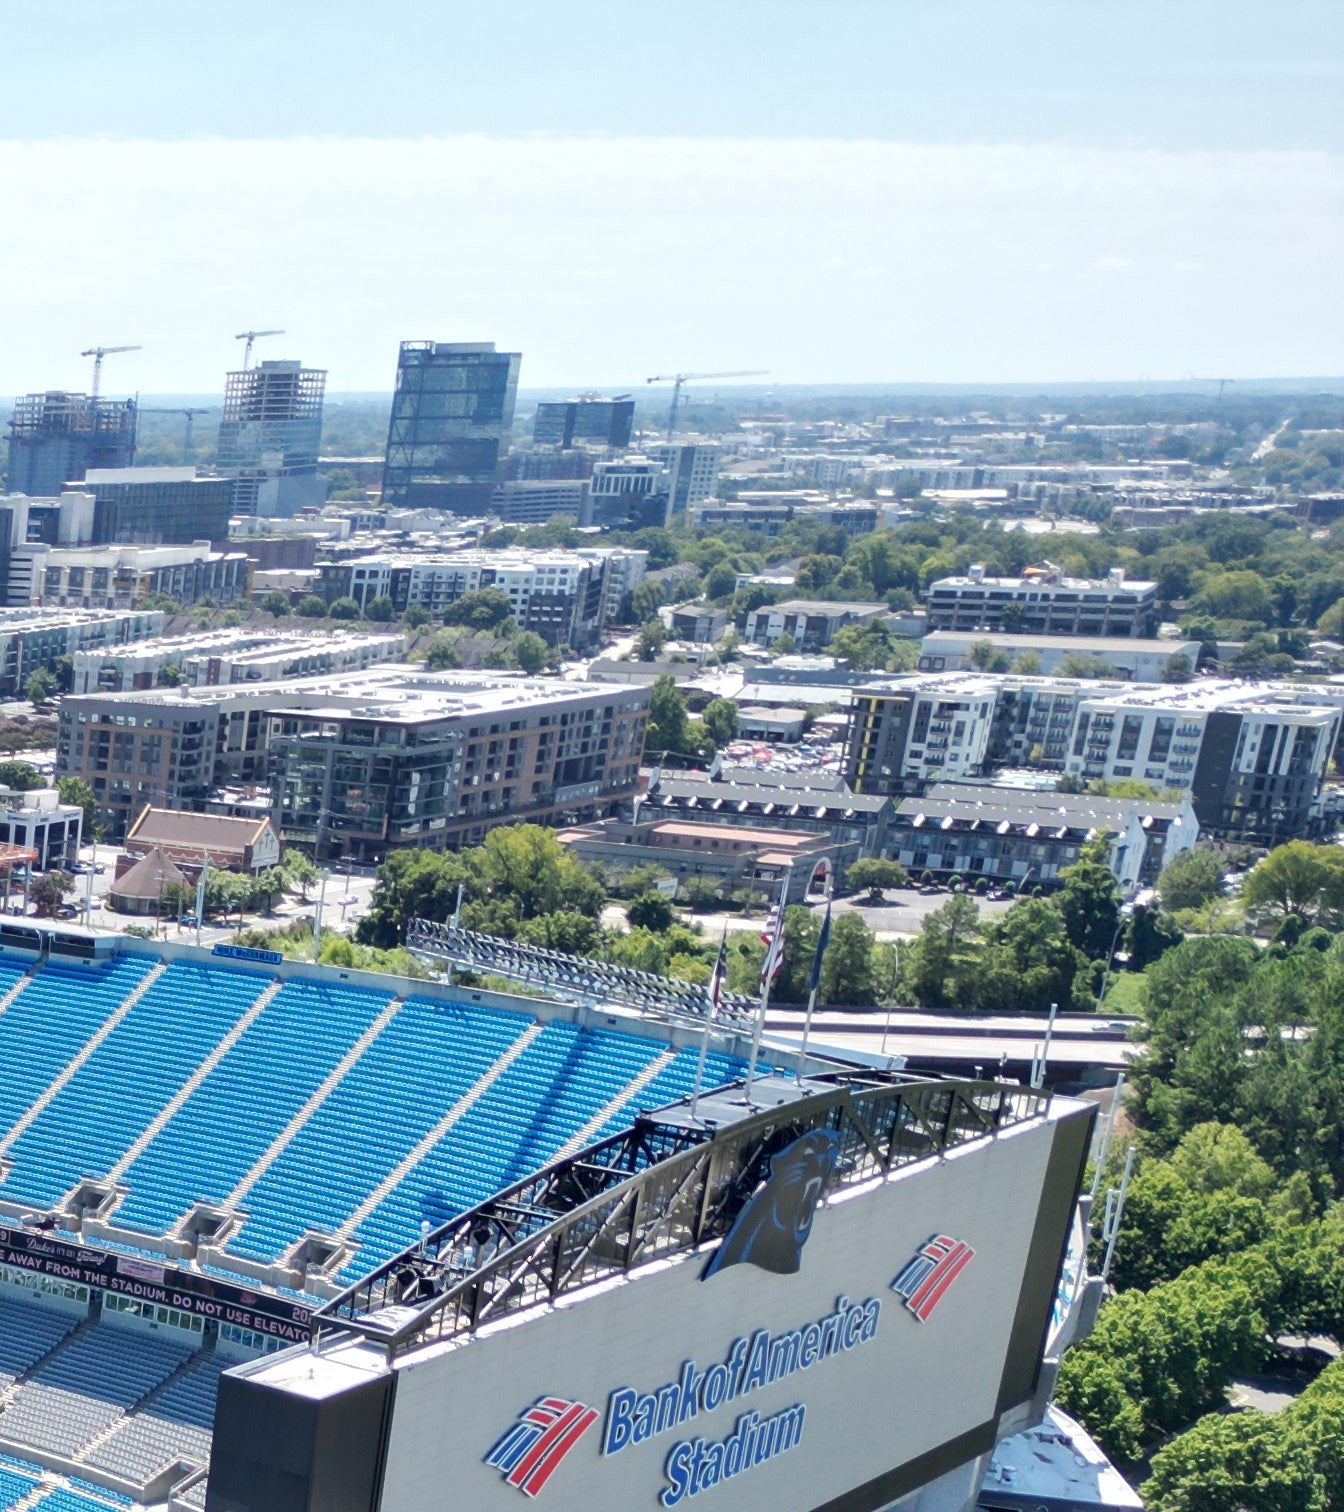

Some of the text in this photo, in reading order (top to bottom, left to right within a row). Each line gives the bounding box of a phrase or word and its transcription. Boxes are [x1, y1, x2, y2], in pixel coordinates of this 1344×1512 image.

[7, 1252, 43, 1270] AWAY
[45, 1261, 80, 1279] FROM
[83, 1271, 108, 1287] THE
[111, 1277, 170, 1303] STADIUM.
[172, 1293, 192, 1309] DO
[195, 1301, 223, 1318] NOT
[226, 1308, 250, 1326] USE
[602, 1294, 882, 1458] Bank of America
[659, 1402, 807, 1508] Stadium
